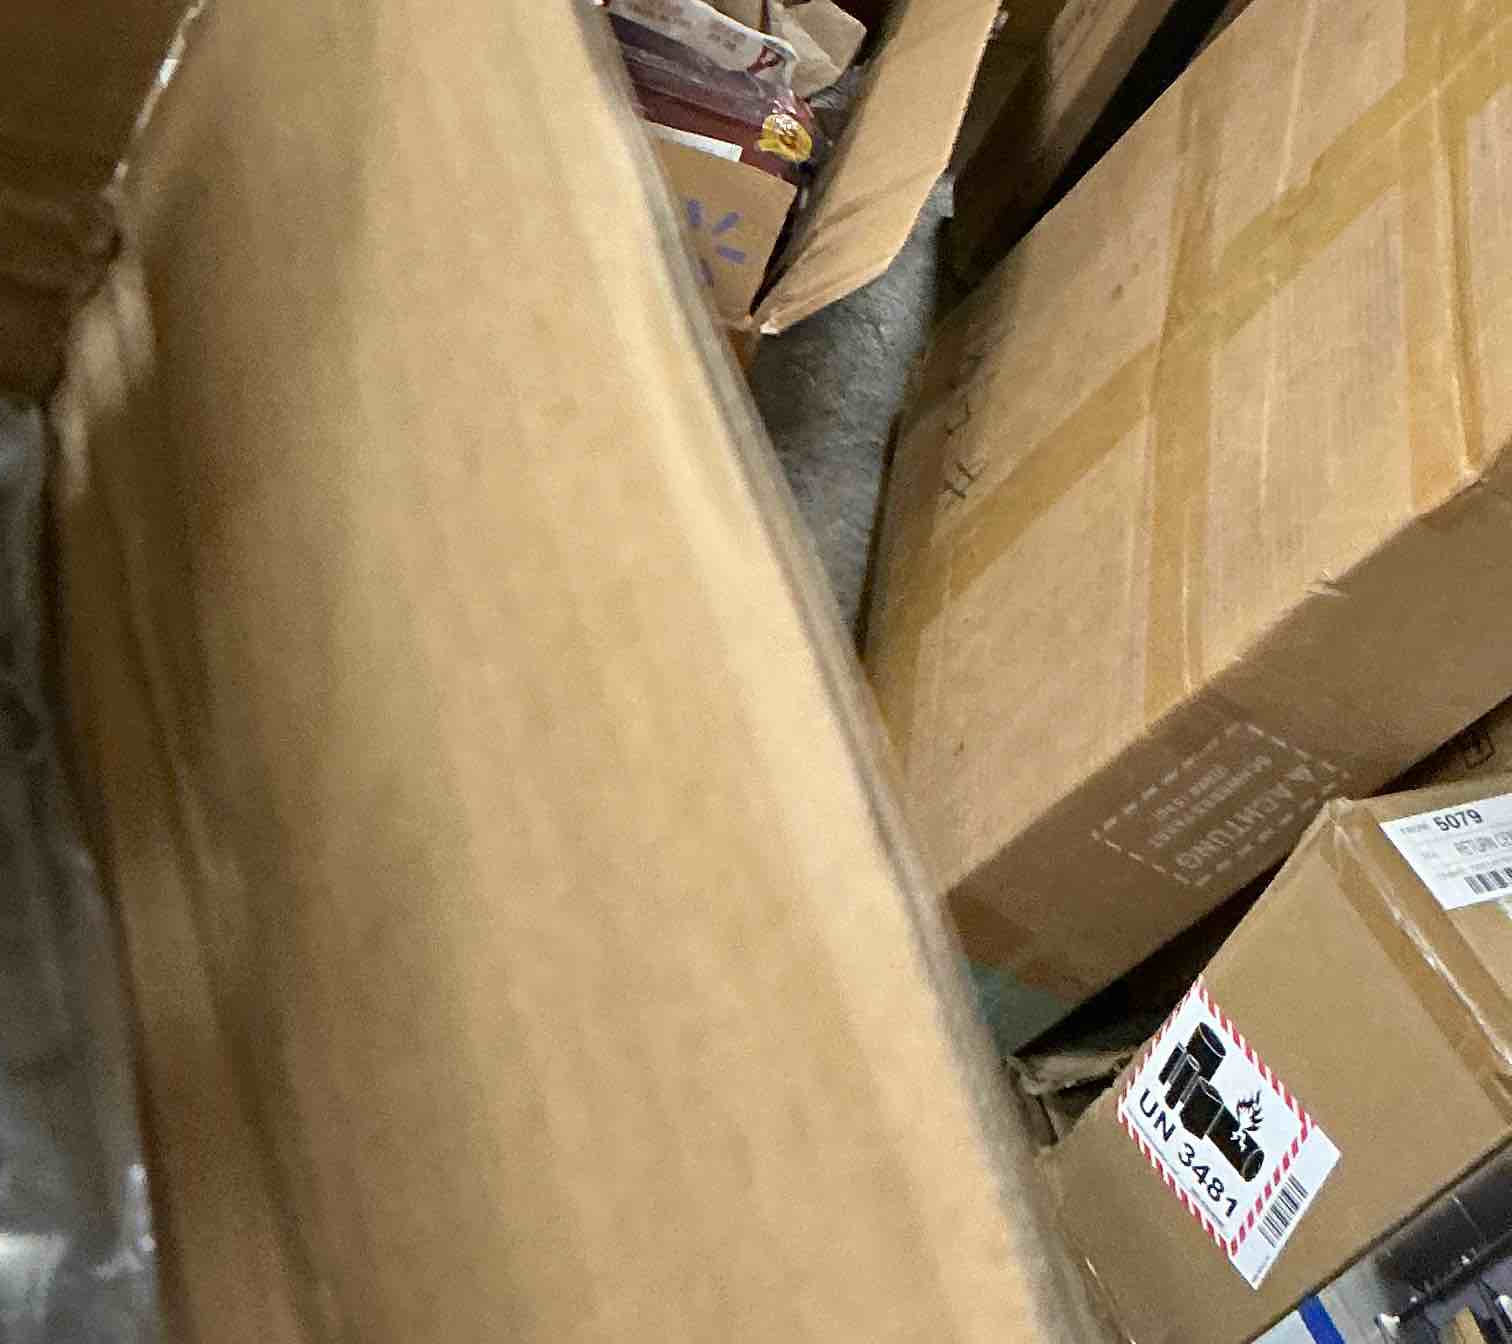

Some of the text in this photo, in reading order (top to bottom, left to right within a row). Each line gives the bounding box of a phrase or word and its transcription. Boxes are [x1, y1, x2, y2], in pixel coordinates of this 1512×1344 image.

[1432, 807, 1484, 834] 5079
[1138, 1087, 1241, 1219] UN 3481
